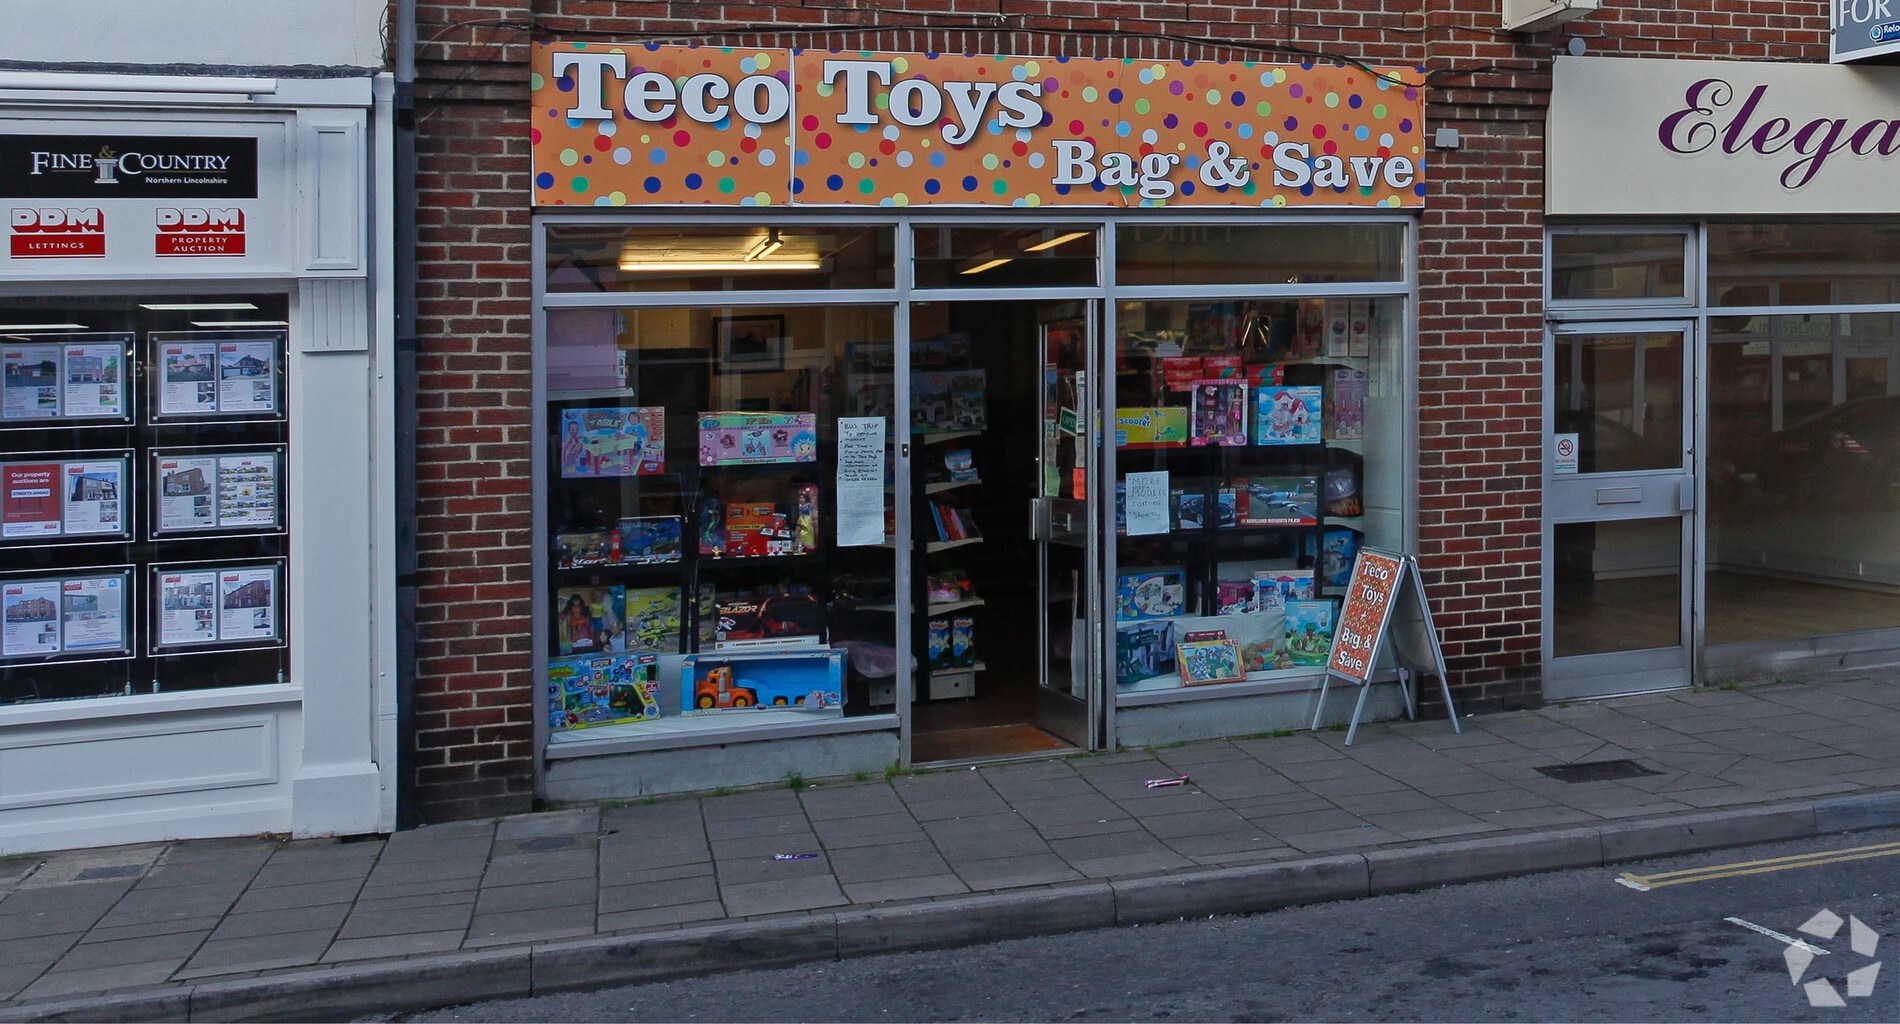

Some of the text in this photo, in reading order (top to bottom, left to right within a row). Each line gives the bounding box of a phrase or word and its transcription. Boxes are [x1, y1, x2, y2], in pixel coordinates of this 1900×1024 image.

[552, 51, 1044, 145] Teco Toys
[30, 151, 93, 175] FINE
[118, 151, 231, 175] COUNTRY
[1051, 139, 1415, 199] Bag & Save
[145, 176, 228, 185] Northern Lincolnshire
[11, 208, 105, 233] DDM
[156, 208, 246, 233] DDM
[171, 236, 228, 244] PROPERTY
[1363, 561, 1389, 580] Teco
[1361, 584, 1385, 605] Toys
[719, 605, 758, 615] BLAZOR
[1342, 628, 1372, 649] Bag &
[1338, 650, 1362, 670] Save
